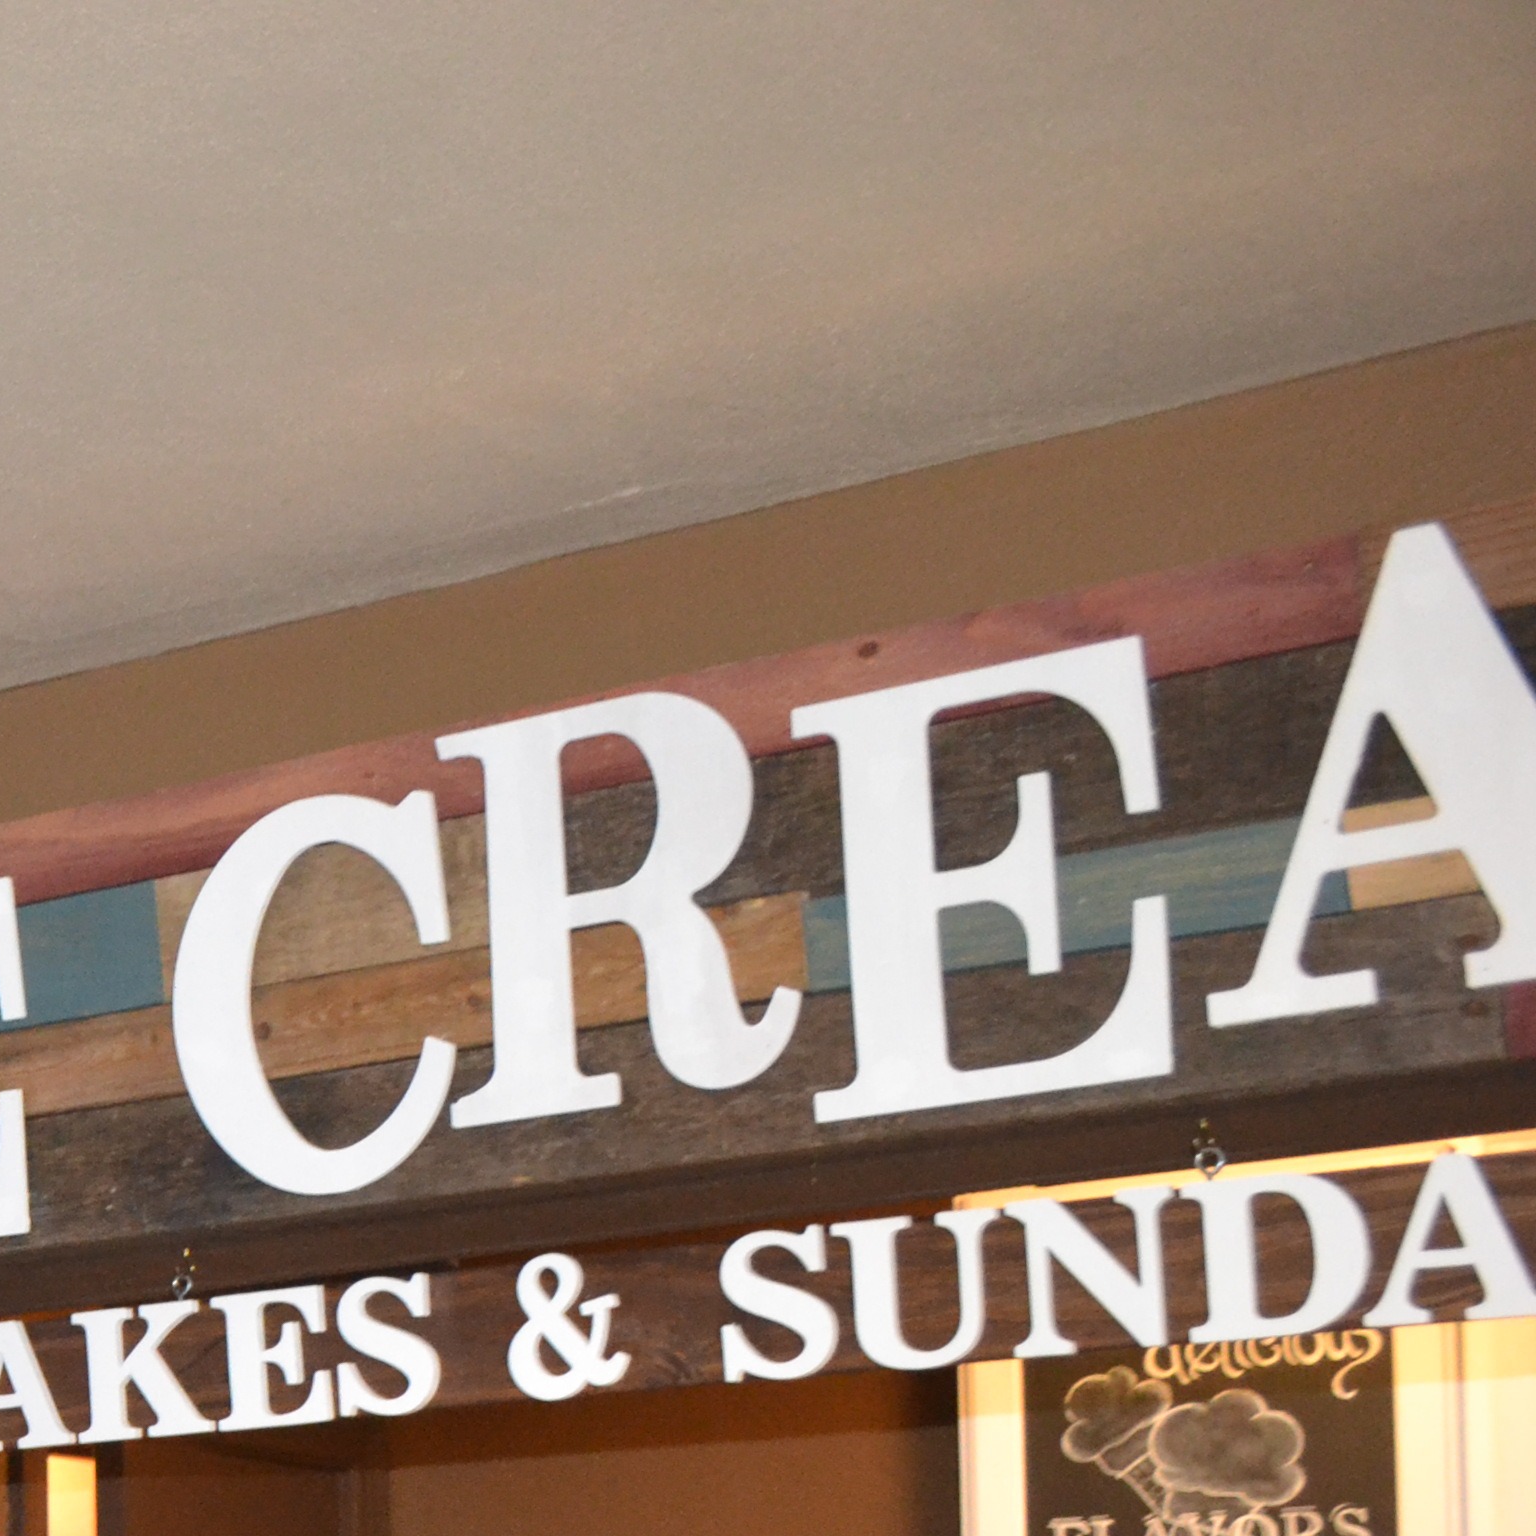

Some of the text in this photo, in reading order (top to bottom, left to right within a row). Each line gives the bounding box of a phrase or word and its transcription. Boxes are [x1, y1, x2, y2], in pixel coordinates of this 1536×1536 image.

[171, 520, 1536, 1196] CREA
[508, 1252, 631, 1402] &
[721, 1153, 1536, 1383] SUNDA
